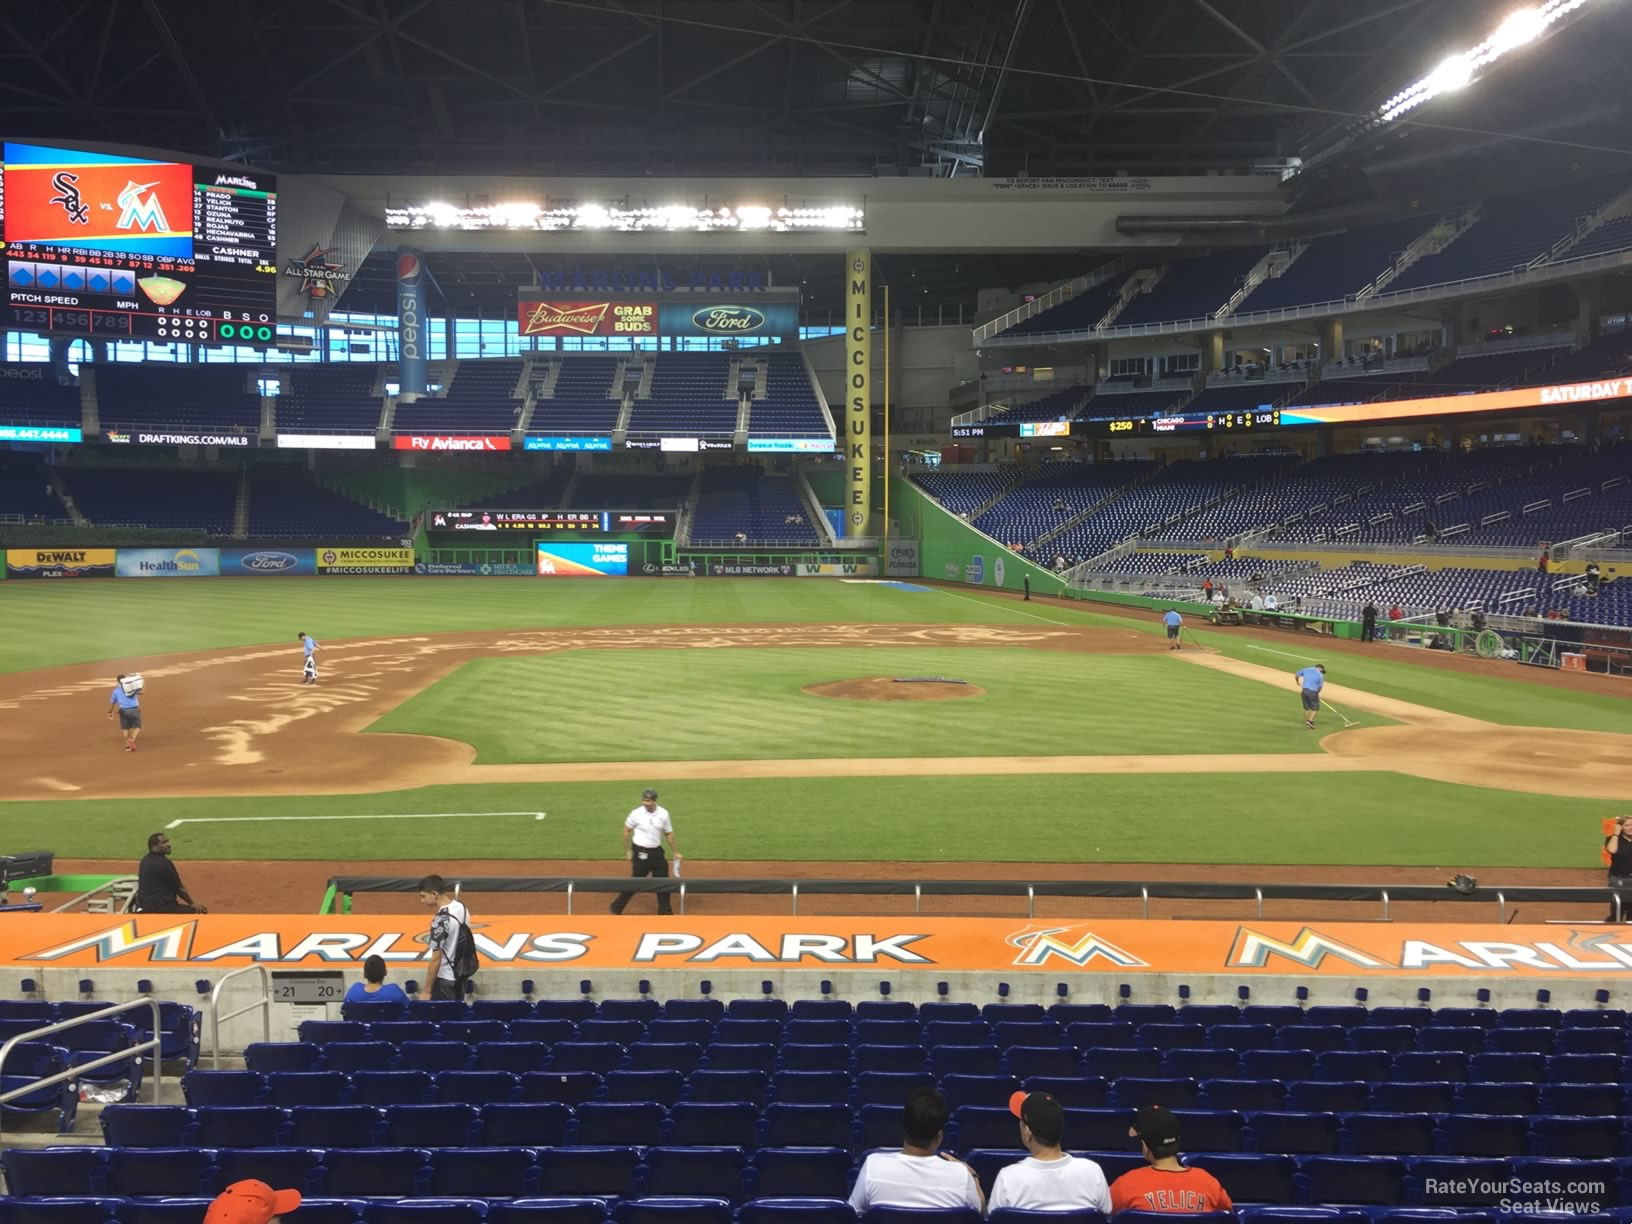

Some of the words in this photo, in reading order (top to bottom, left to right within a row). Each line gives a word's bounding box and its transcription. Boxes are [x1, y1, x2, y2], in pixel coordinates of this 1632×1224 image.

[215, 175, 257, 189] MARLINS
[206, 198, 232, 206] YELICH
[206, 204, 239, 213] STANTON
[206, 210, 232, 218] OZUNA
[206, 216, 245, 226] REALMUTO
[206, 222, 229, 230] ROJAS
[206, 229, 256, 239] HECHAVARRIA
[10, 242, 23, 250] AB
[29, 243, 38, 251] R
[57, 247, 71, 255] HR
[72, 248, 88, 256] RBI
[88, 250, 101, 258] BB
[102, 251, 114, 259] 2B
[114, 252, 126, 260] 3B
[128, 253, 142, 261] SO
[142, 254, 154, 262] SB
[156, 256, 176, 264] OBP
[176, 257, 195, 265] AVG
[212, 246, 260, 258] CASHNER
[255, 264, 277, 274] 4.96
[324, 270, 352, 281] GAME
[541, 271, 677, 292] MARLINS
[690, 271, 767, 292] PARK
[11, 293, 42, 303] PITCH
[44, 296, 79, 305] SPEED
[116, 301, 140, 310] MPH
[195, 309, 212, 317] LOB
[223, 311, 232, 320] B
[242, 312, 251, 321] S
[613, 306, 653, 316] GRAB
[528, 309, 606, 325] Budweiser
[704, 309, 752, 329] Ford
[401, 292, 421, 360] pepsi
[614, 322, 653, 332] BUDS
[851, 279, 866, 506] MICCOSUKEE
[1540, 381, 1621, 403] SATURDAY
[1157, 417, 1184, 426] CHICAGO
[1219, 417, 1225, 425] H
[1237, 416, 1243, 424] E
[1256, 414, 1272, 424] LOB
[1109, 422, 1133, 432] $250
[953, 428, 971, 437] 5:51
[972, 428, 984, 437] PM
[139, 434, 248, 446] DRAFTKINGS.COM/MLB
[411, 437, 428, 450] Fly
[431, 437, 484, 449] Avianca
[340, 550, 410, 559] MICCOSUKEE
[252, 555, 287, 569] Ford
[889, 561, 917, 569] FLORIDA
[725, 566, 741, 574] MLB
[742, 566, 780, 574] NETWORK
[14, 919, 598, 962] MARLNS
[631, 932, 938, 964] PARK
[282, 986, 295, 997] 21
[317, 985, 334, 997] 20
[1143, 1189, 1206, 1212] YELICH
